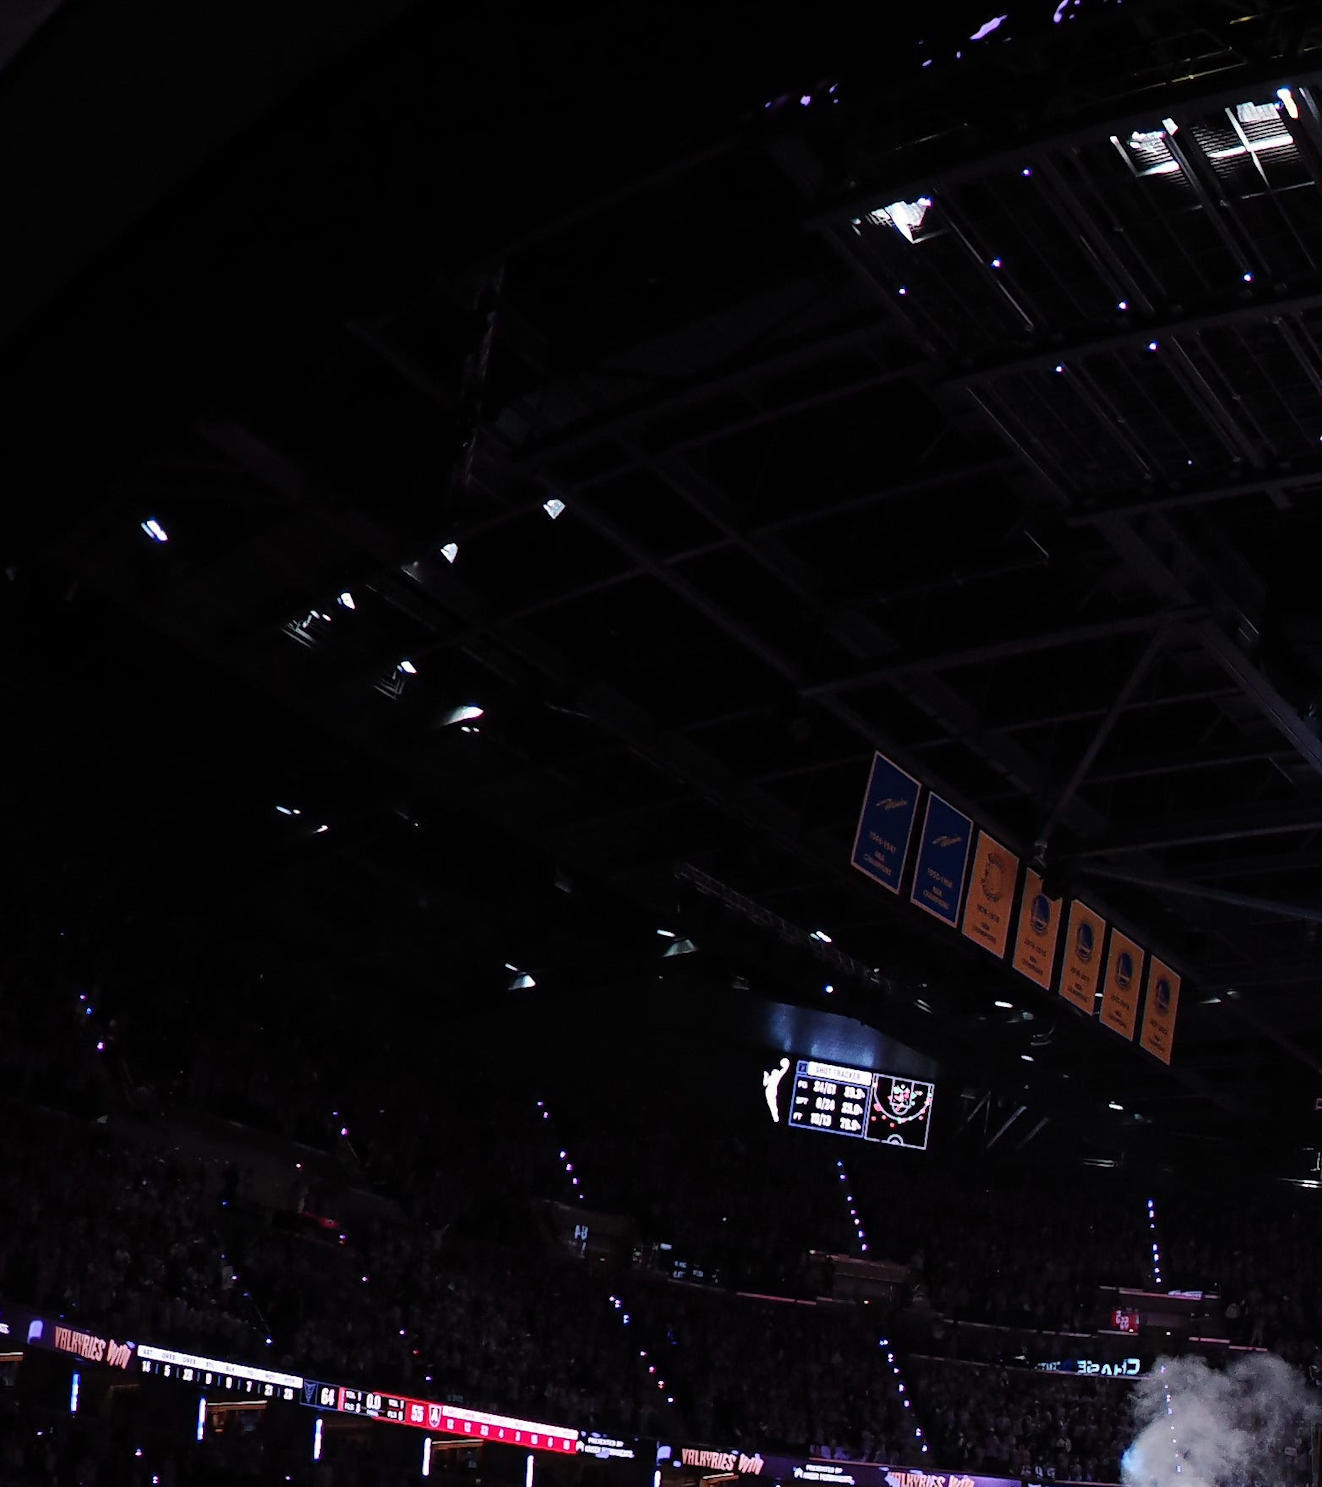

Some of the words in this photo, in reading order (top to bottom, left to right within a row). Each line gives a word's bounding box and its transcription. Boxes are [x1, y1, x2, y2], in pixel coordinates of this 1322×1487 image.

[56, 1327, 106, 1361] VALKYRIES
[107, 1338, 131, 1371] WIN
[321, 1388, 335, 1405] 64
[682, 1448, 737, 1471] VALKYRIES
[738, 1453, 764, 1475] WIN
